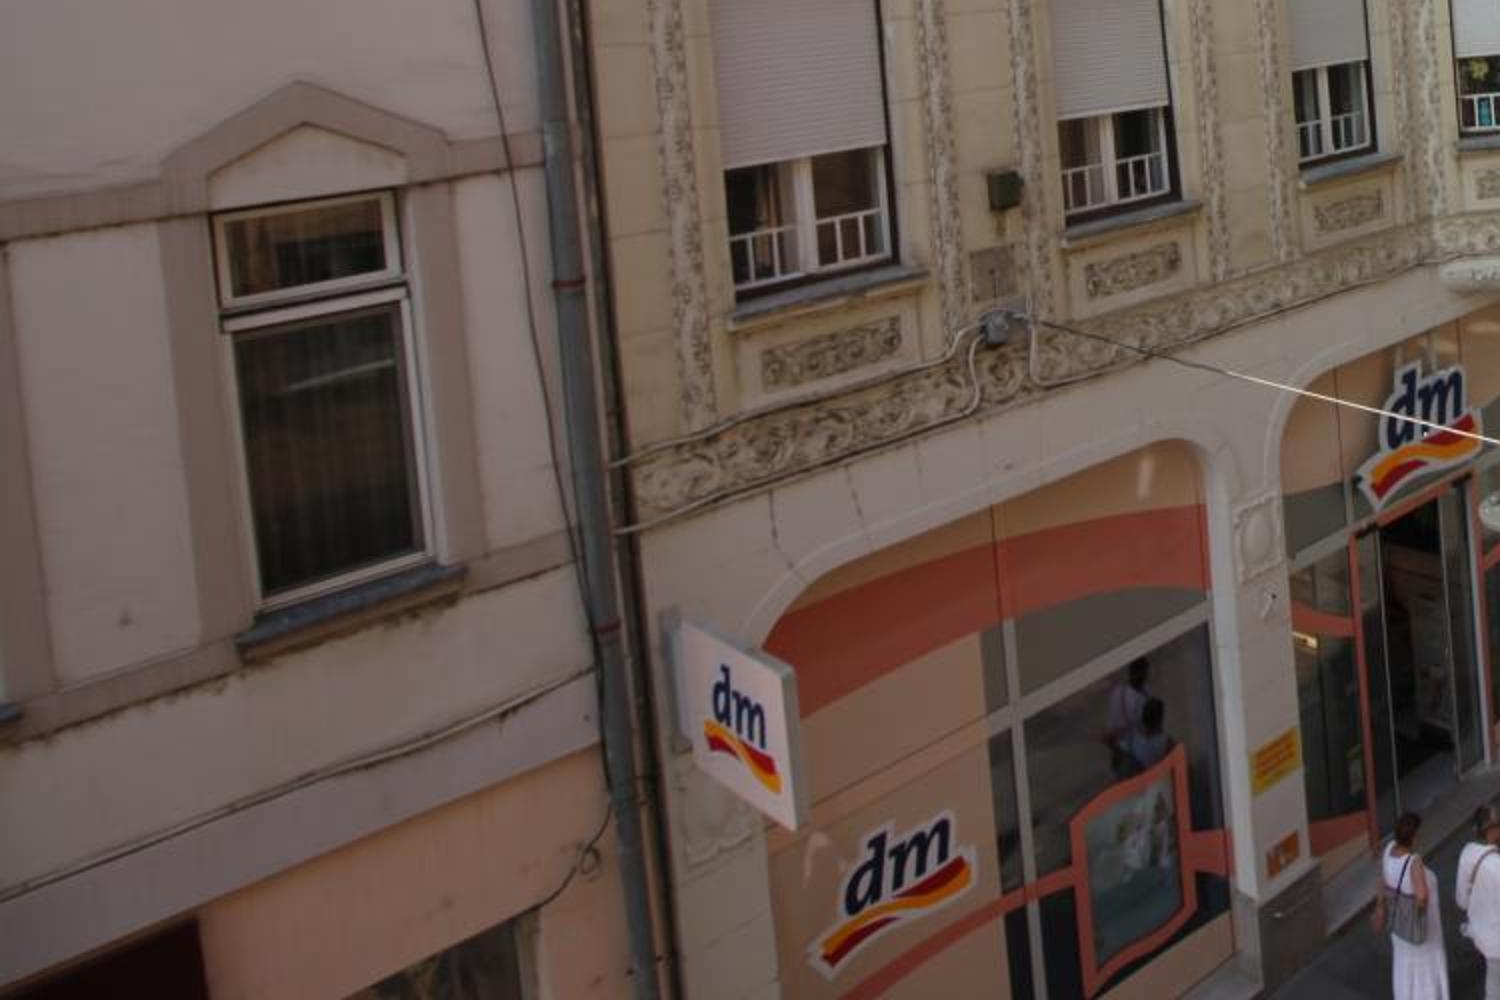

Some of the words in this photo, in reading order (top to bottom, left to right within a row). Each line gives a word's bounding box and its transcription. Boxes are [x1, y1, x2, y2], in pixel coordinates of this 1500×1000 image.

[1387, 369, 1462, 449] dm
[713, 664, 765, 750] dm
[845, 818, 950, 915] dm
